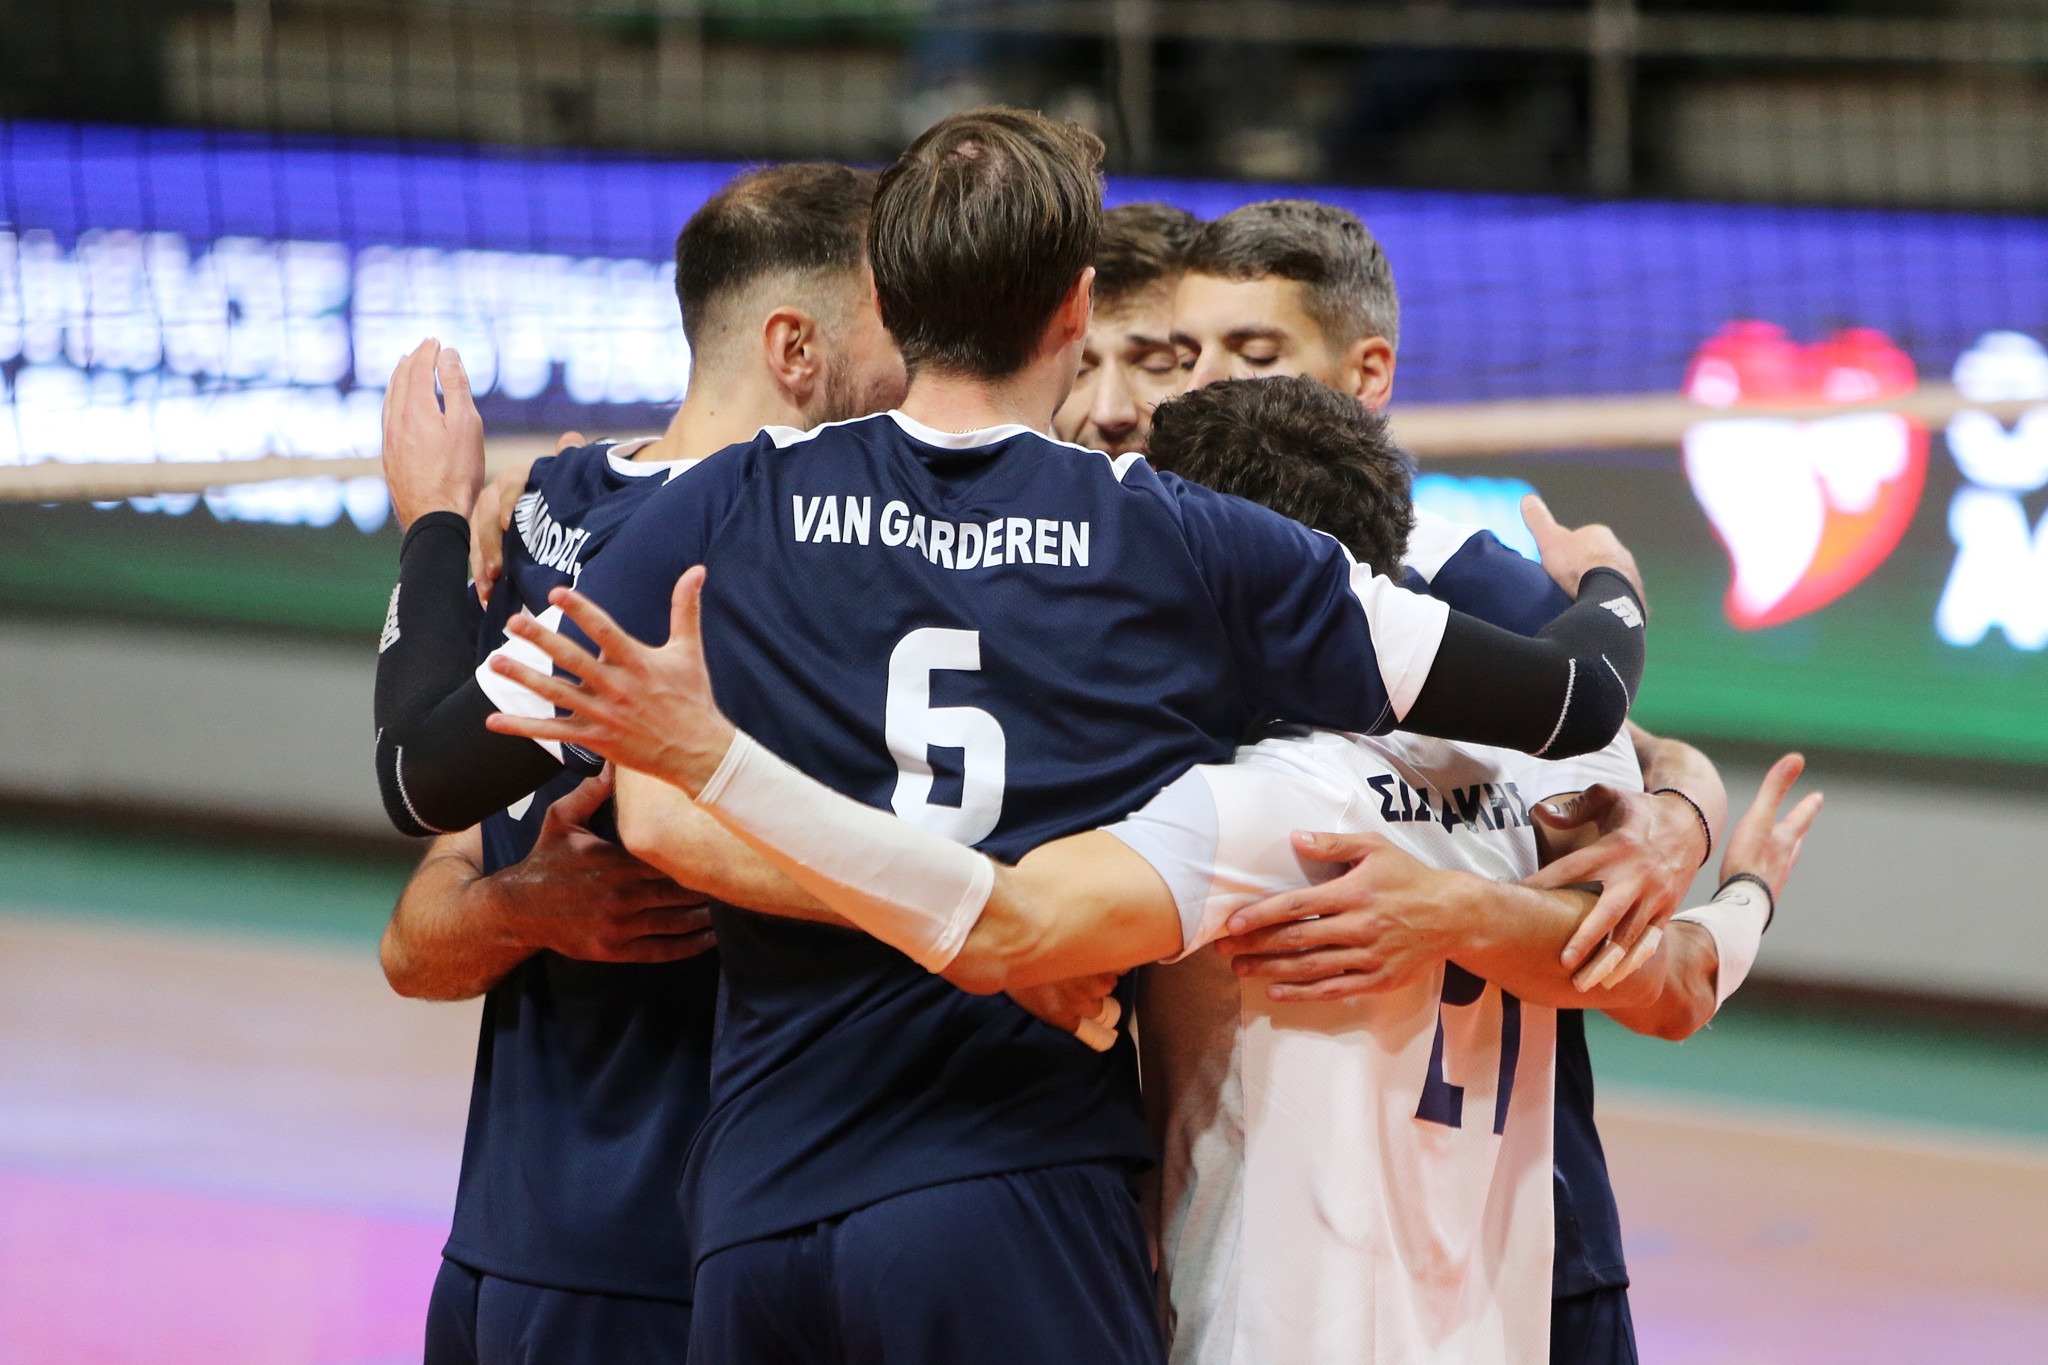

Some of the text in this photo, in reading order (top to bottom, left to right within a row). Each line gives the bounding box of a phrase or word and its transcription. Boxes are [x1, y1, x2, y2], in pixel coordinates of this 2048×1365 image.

[793, 495, 1090, 570] VAN GARDEREN
[885, 627, 1006, 848] 6
